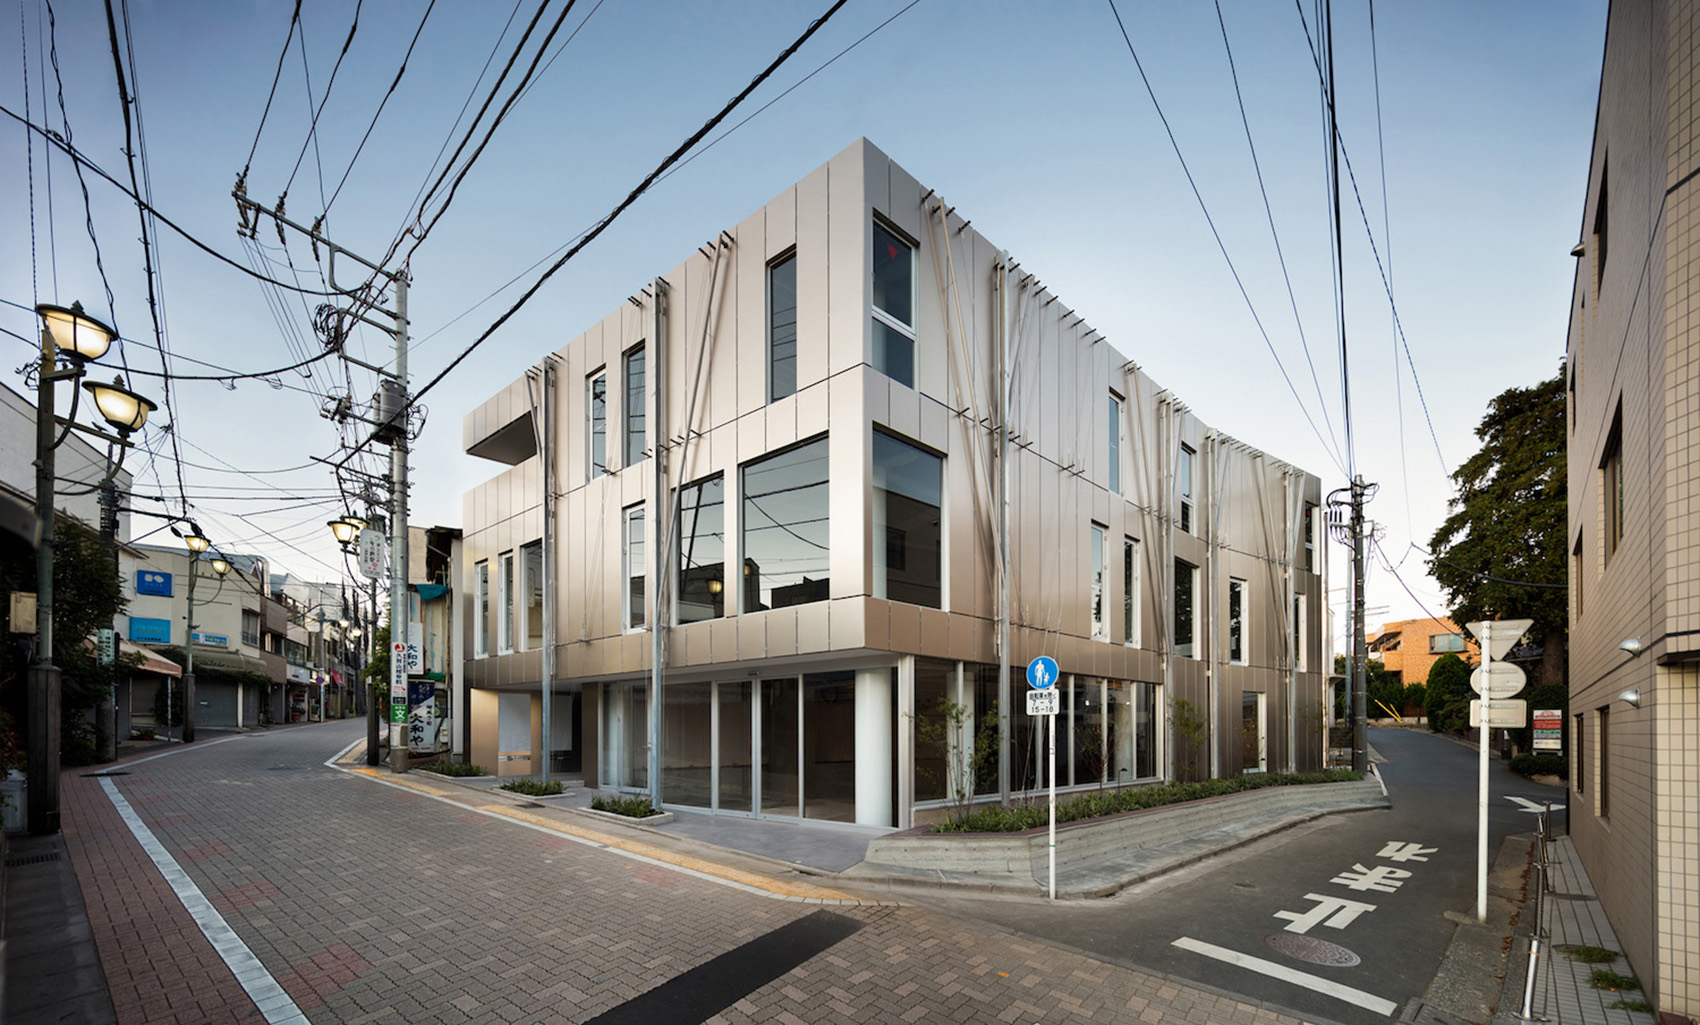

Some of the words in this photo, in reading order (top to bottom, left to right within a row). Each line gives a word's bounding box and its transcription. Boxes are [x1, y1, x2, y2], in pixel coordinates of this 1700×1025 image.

[407, 643, 418, 669] 大和や
[410, 713, 424, 746] 大和や
[1272, 840, 1440, 935] 止まれ
